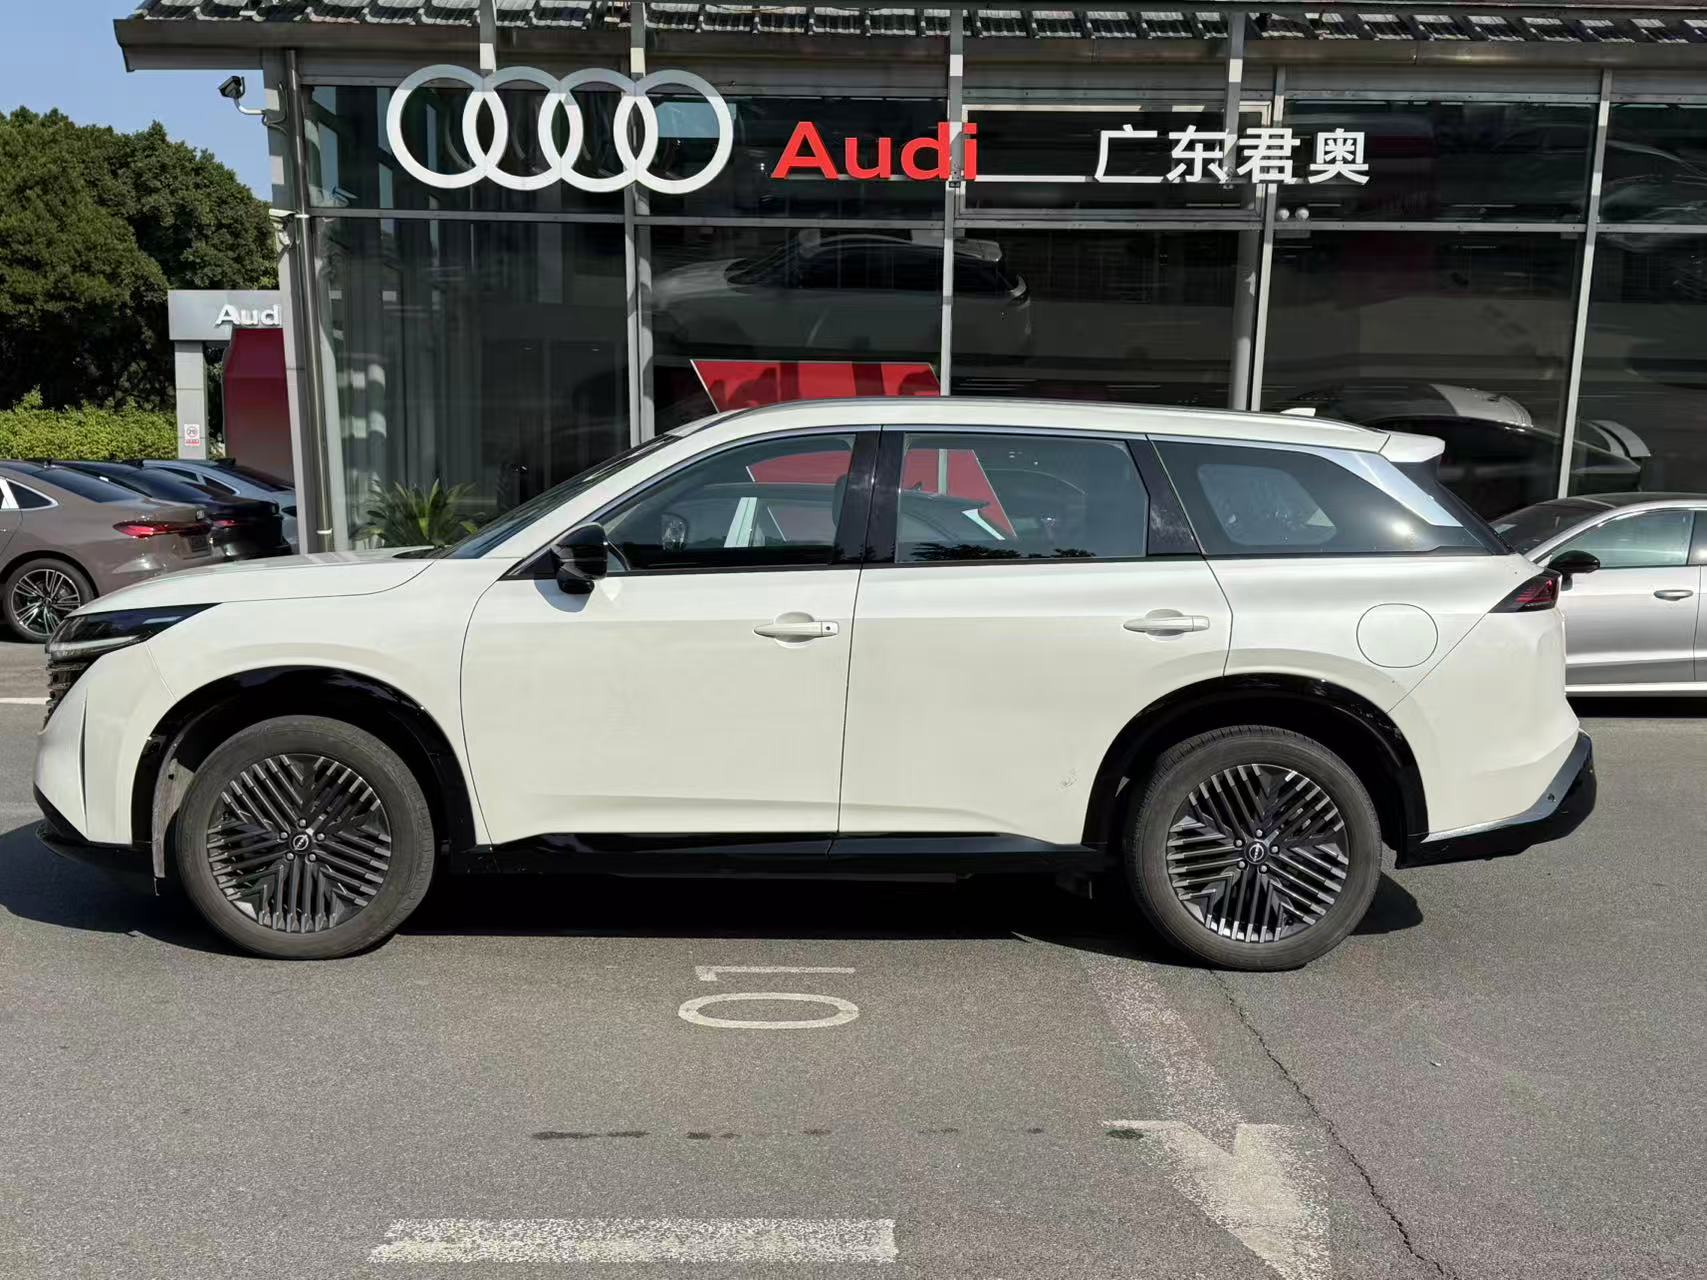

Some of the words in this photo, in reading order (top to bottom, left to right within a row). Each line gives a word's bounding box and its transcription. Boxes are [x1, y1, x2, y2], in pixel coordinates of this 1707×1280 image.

[771, 121, 978, 181] Audi
[1094, 125, 1370, 186] 广东君奥
